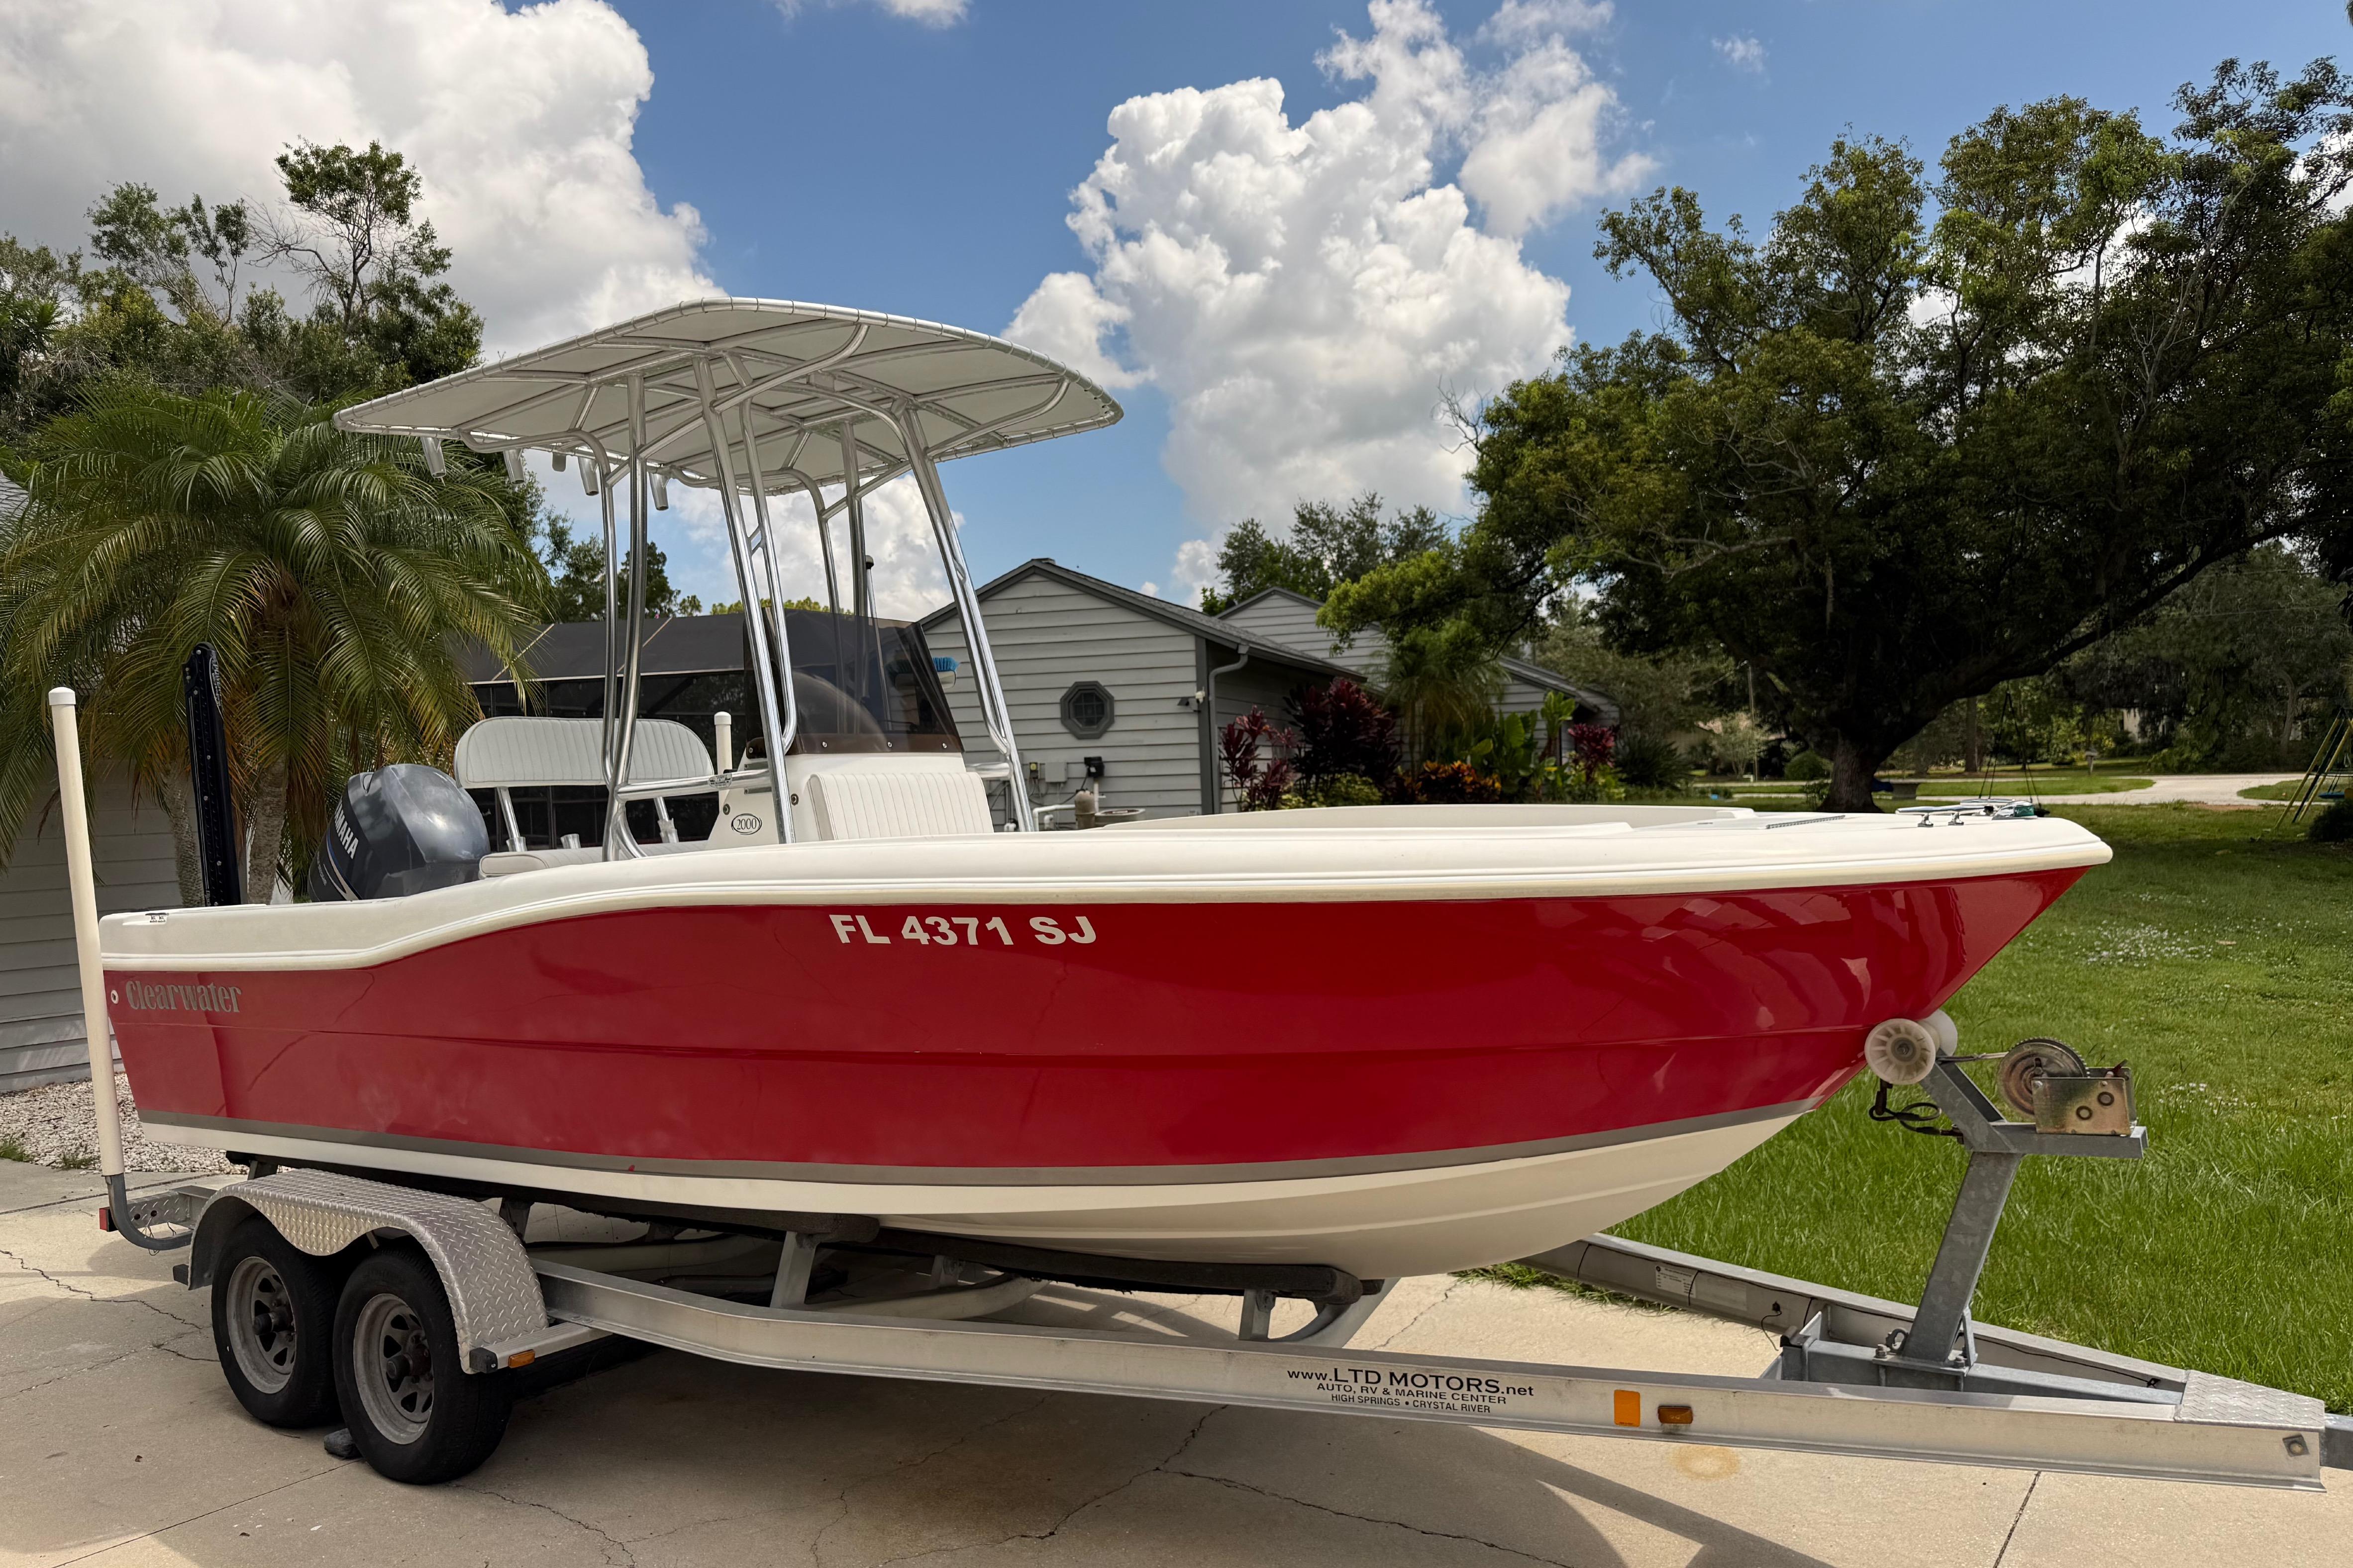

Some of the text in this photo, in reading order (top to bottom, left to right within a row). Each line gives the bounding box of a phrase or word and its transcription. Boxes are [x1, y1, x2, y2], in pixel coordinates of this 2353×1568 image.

[737, 818, 757, 830] 2000
[829, 914, 1097, 945] FL 4371 SJ
[125, 980, 242, 1013] Clearwater
[1287, 1368, 1534, 1396] www.LTD MOTORS.net
[1317, 1382, 1507, 1404] AUTO, RV & MARINE CENTER
[1331, 1393, 1491, 1414] HIGH SPRINGS CRYSTAL RIVER
